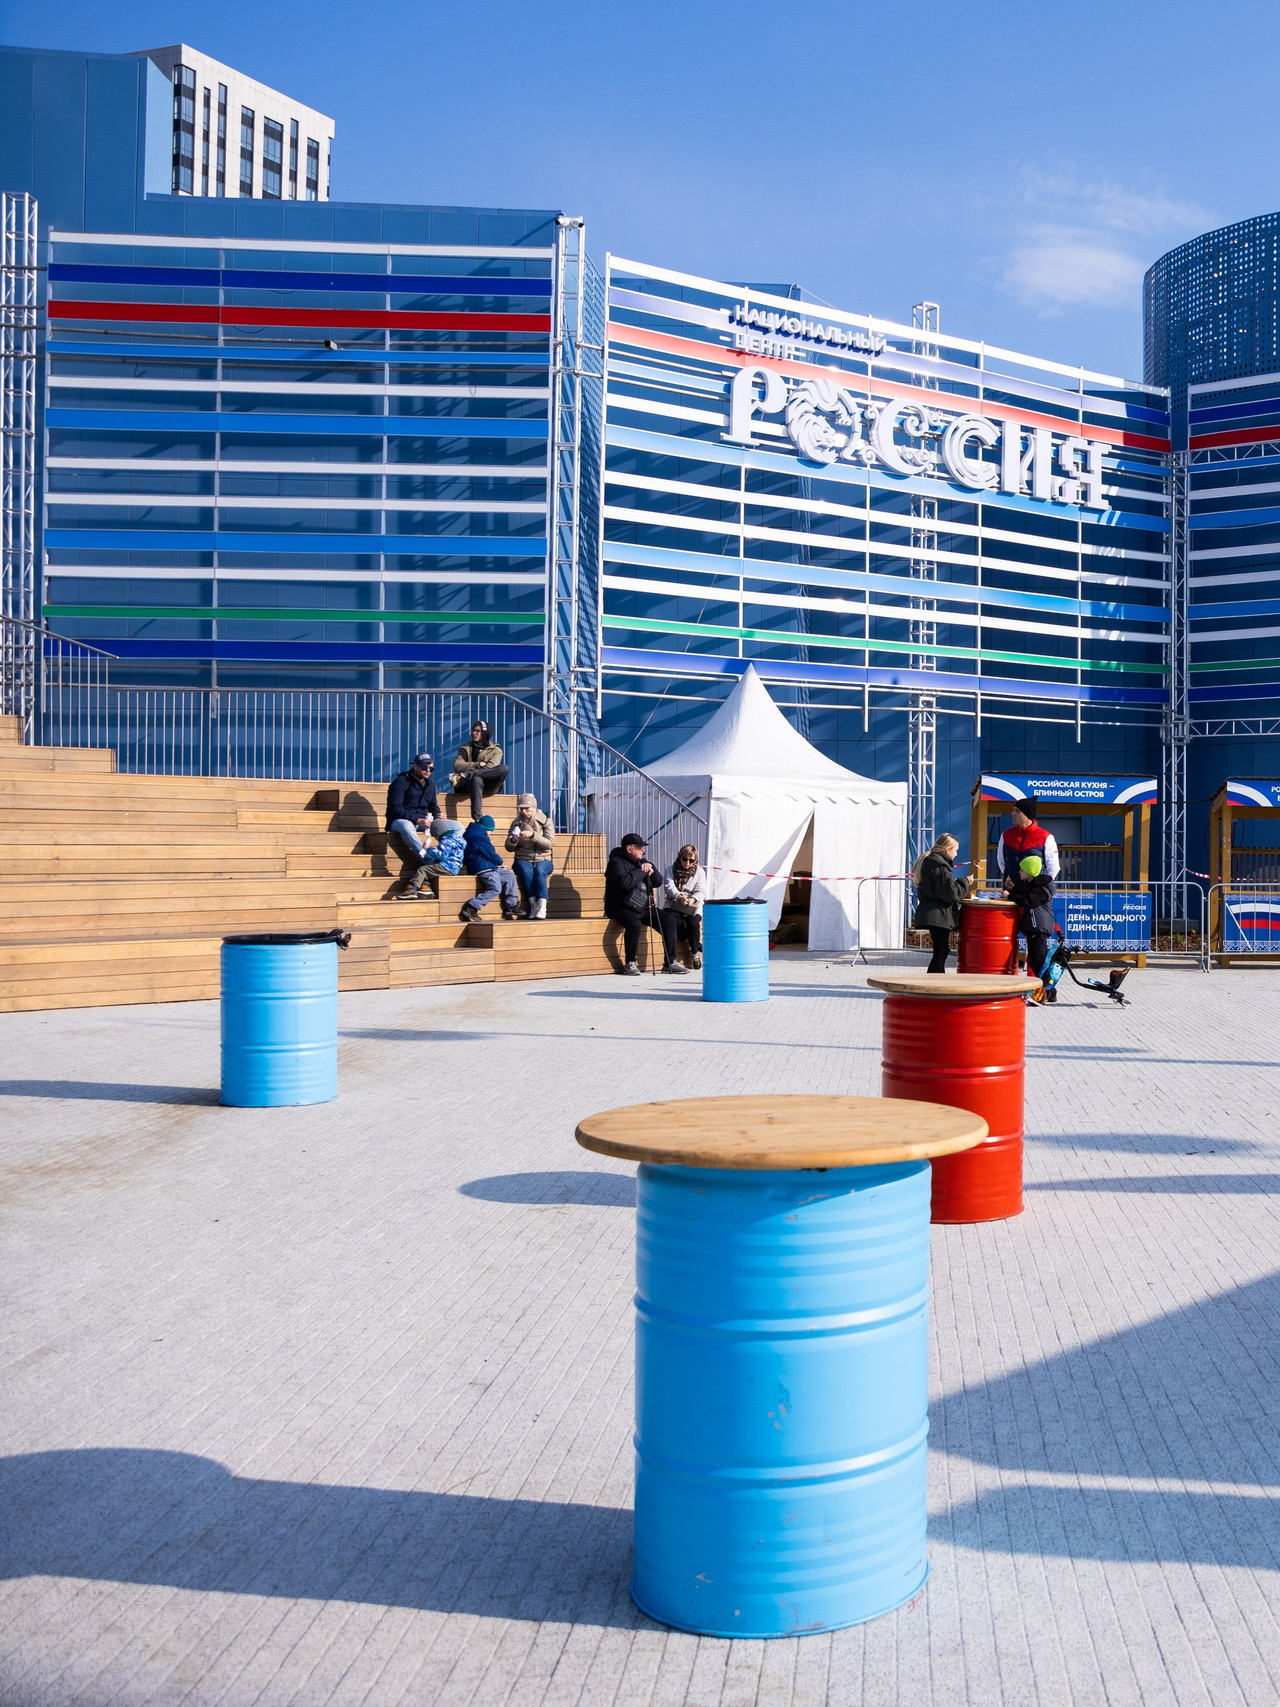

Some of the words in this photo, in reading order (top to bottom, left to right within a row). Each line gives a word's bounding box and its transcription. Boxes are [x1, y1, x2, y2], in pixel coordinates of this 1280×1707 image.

[734, 305, 887, 352] НАЦИОНАЛЬНЫЙ
[733, 333, 795, 359] ЦЕНТР
[720, 366, 1112, 510] РОССИЯ
[1027, 780, 1080, 788] РОССИЙСКАЯ
[1081, 781, 1107, 789] КУХНЯ
[1033, 789, 1073, 797] БЛИННЫЙ
[1067, 914, 1090, 922] ДЕНЬ
[1092, 914, 1147, 922] НАРОДНОГО
[1067, 924, 1114, 932] ЕДИНСТВА
